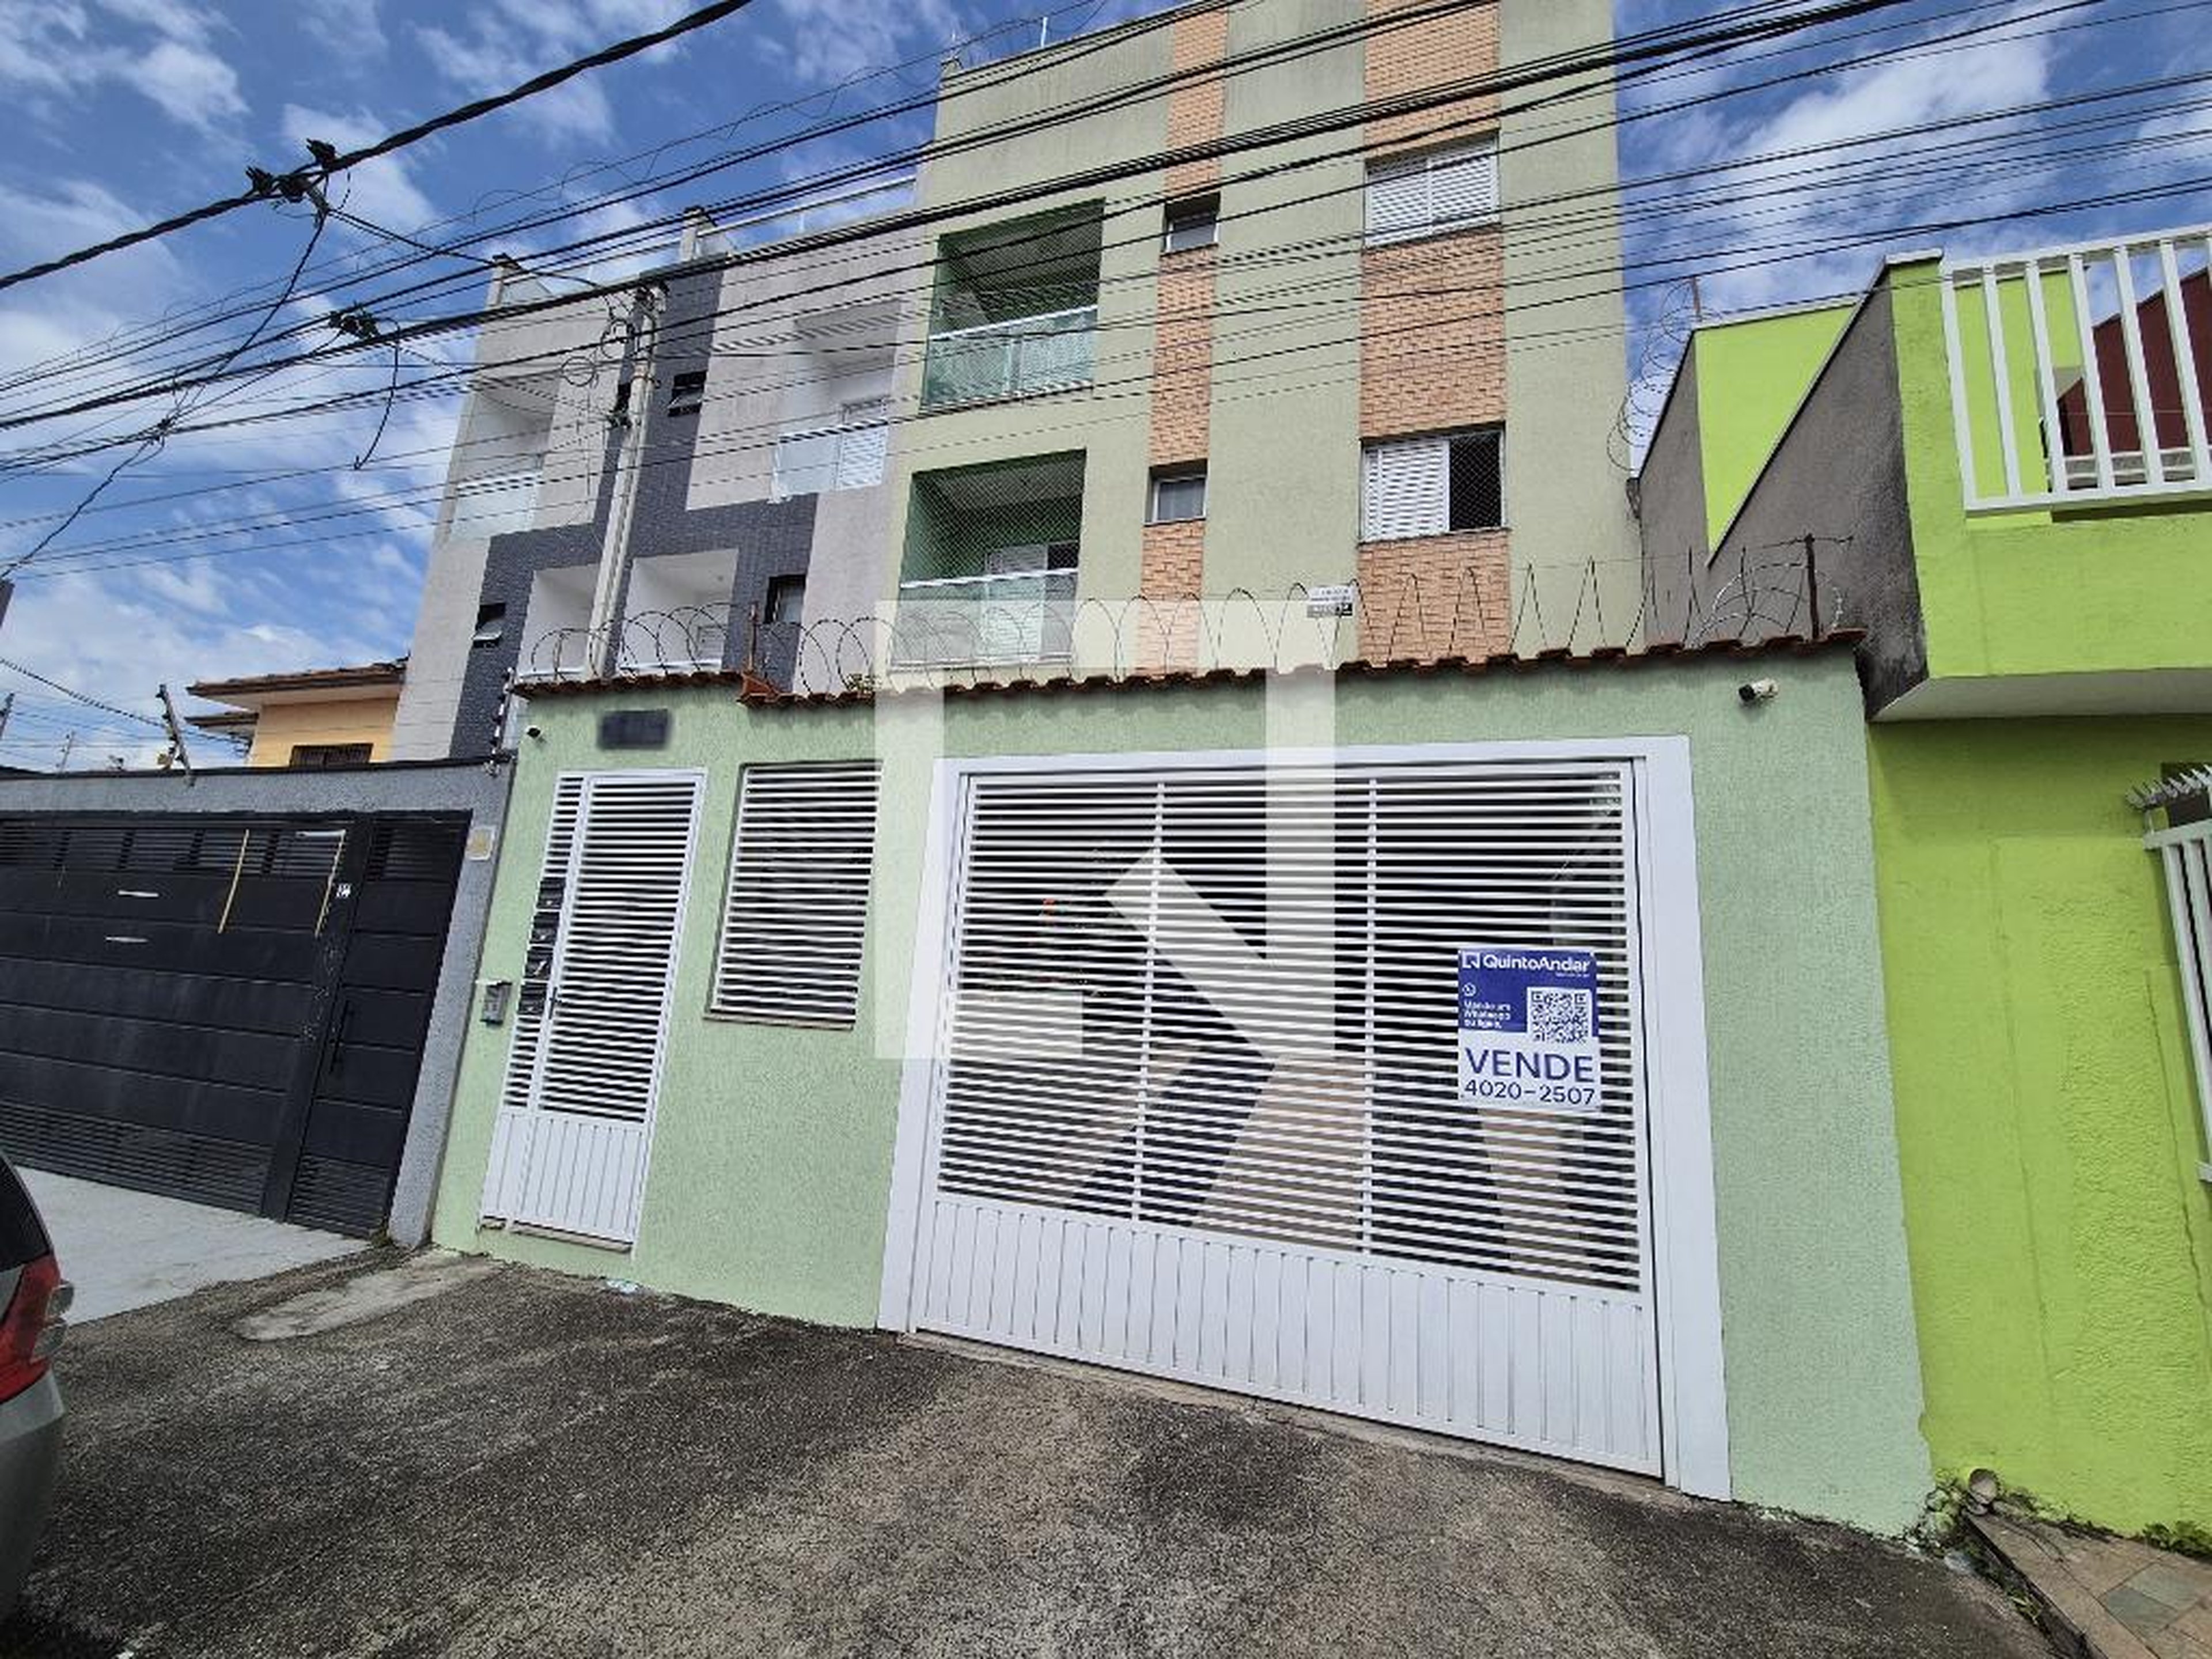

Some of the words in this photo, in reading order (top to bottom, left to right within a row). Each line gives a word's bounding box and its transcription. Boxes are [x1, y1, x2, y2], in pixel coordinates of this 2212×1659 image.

[1483, 954, 1590, 972] QuintoAndar
[1465, 1047, 1595, 1083] VENDE
[1464, 1079, 1596, 1105] 4020-2507
